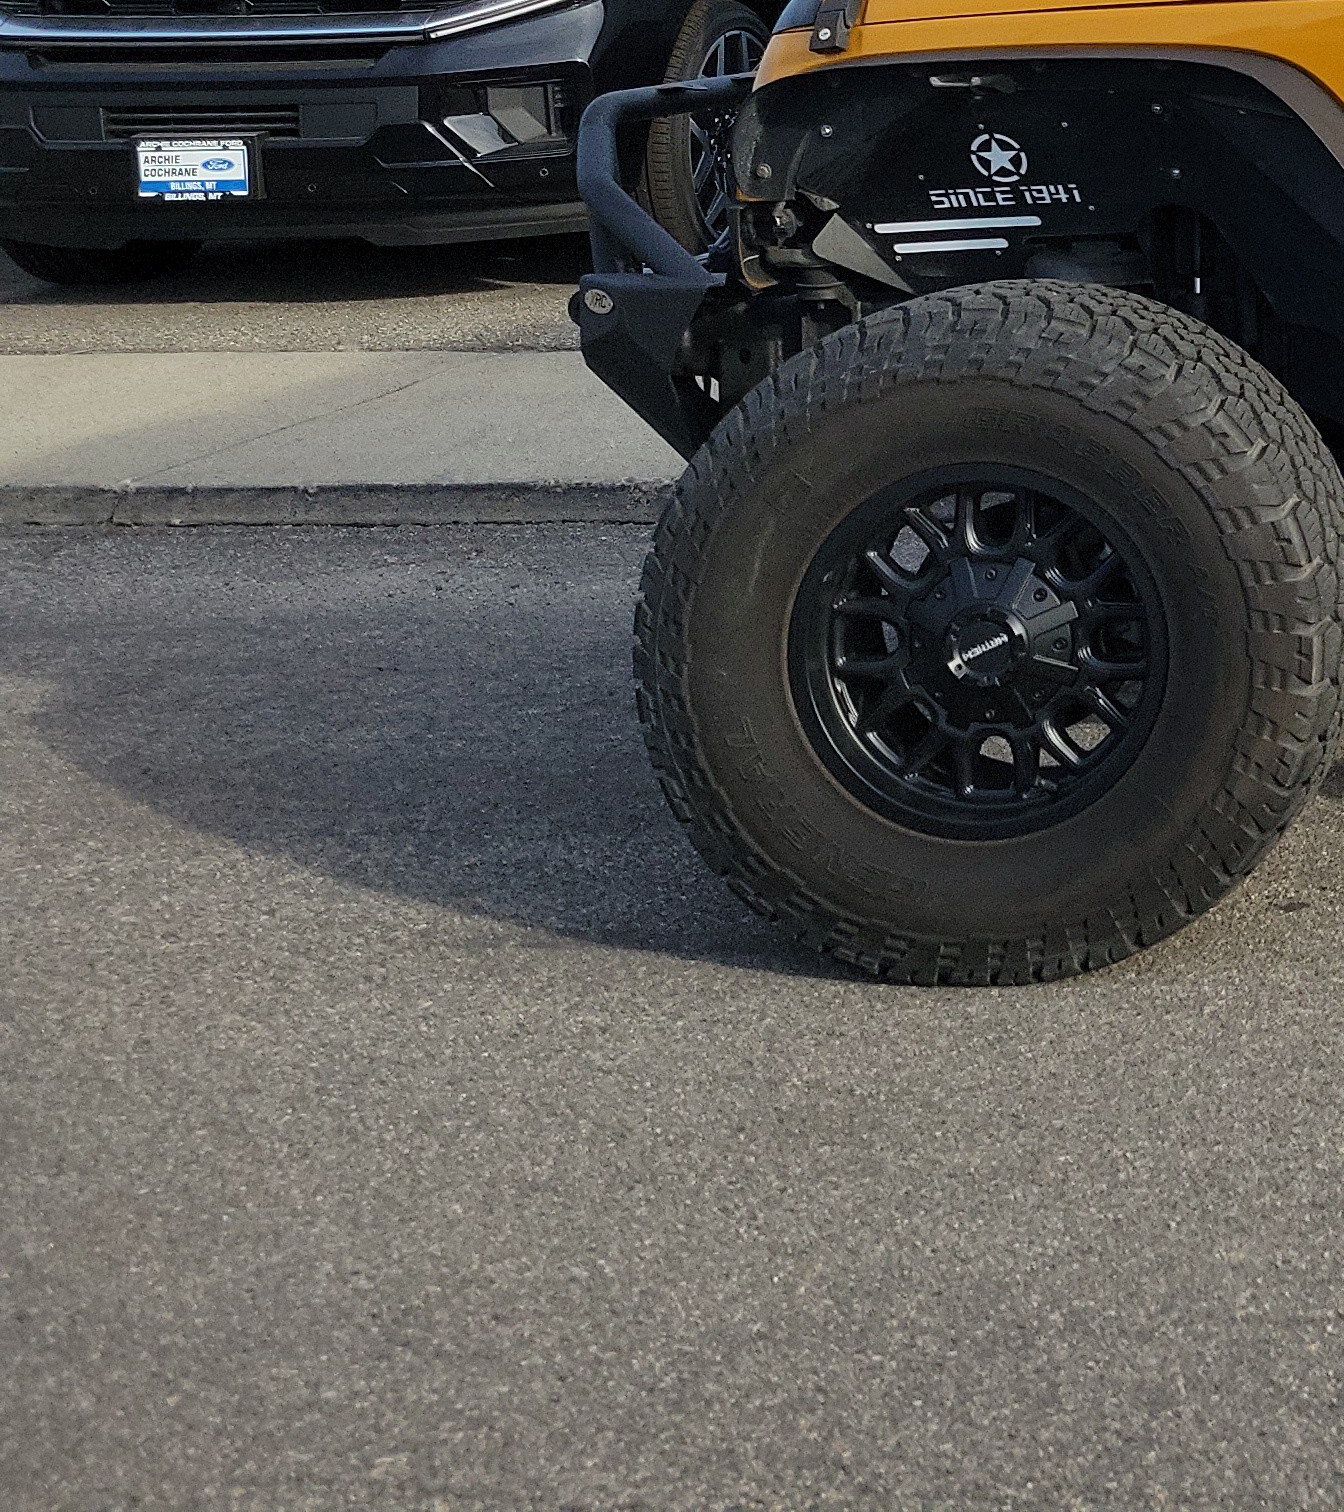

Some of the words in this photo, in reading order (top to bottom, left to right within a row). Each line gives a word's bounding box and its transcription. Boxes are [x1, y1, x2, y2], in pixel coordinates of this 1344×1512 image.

[139, 140, 171, 148] ARCHIE
[171, 140, 219, 148] COCHRANE
[220, 139, 244, 147] FORD
[142, 154, 181, 165] ARCHIE
[207, 159, 229, 170] Ford
[143, 167, 198, 178] COCHRANE
[205, 181, 218, 191] MT
[208, 192, 223, 200] MT
[1019, 183, 1082, 205] 1941
